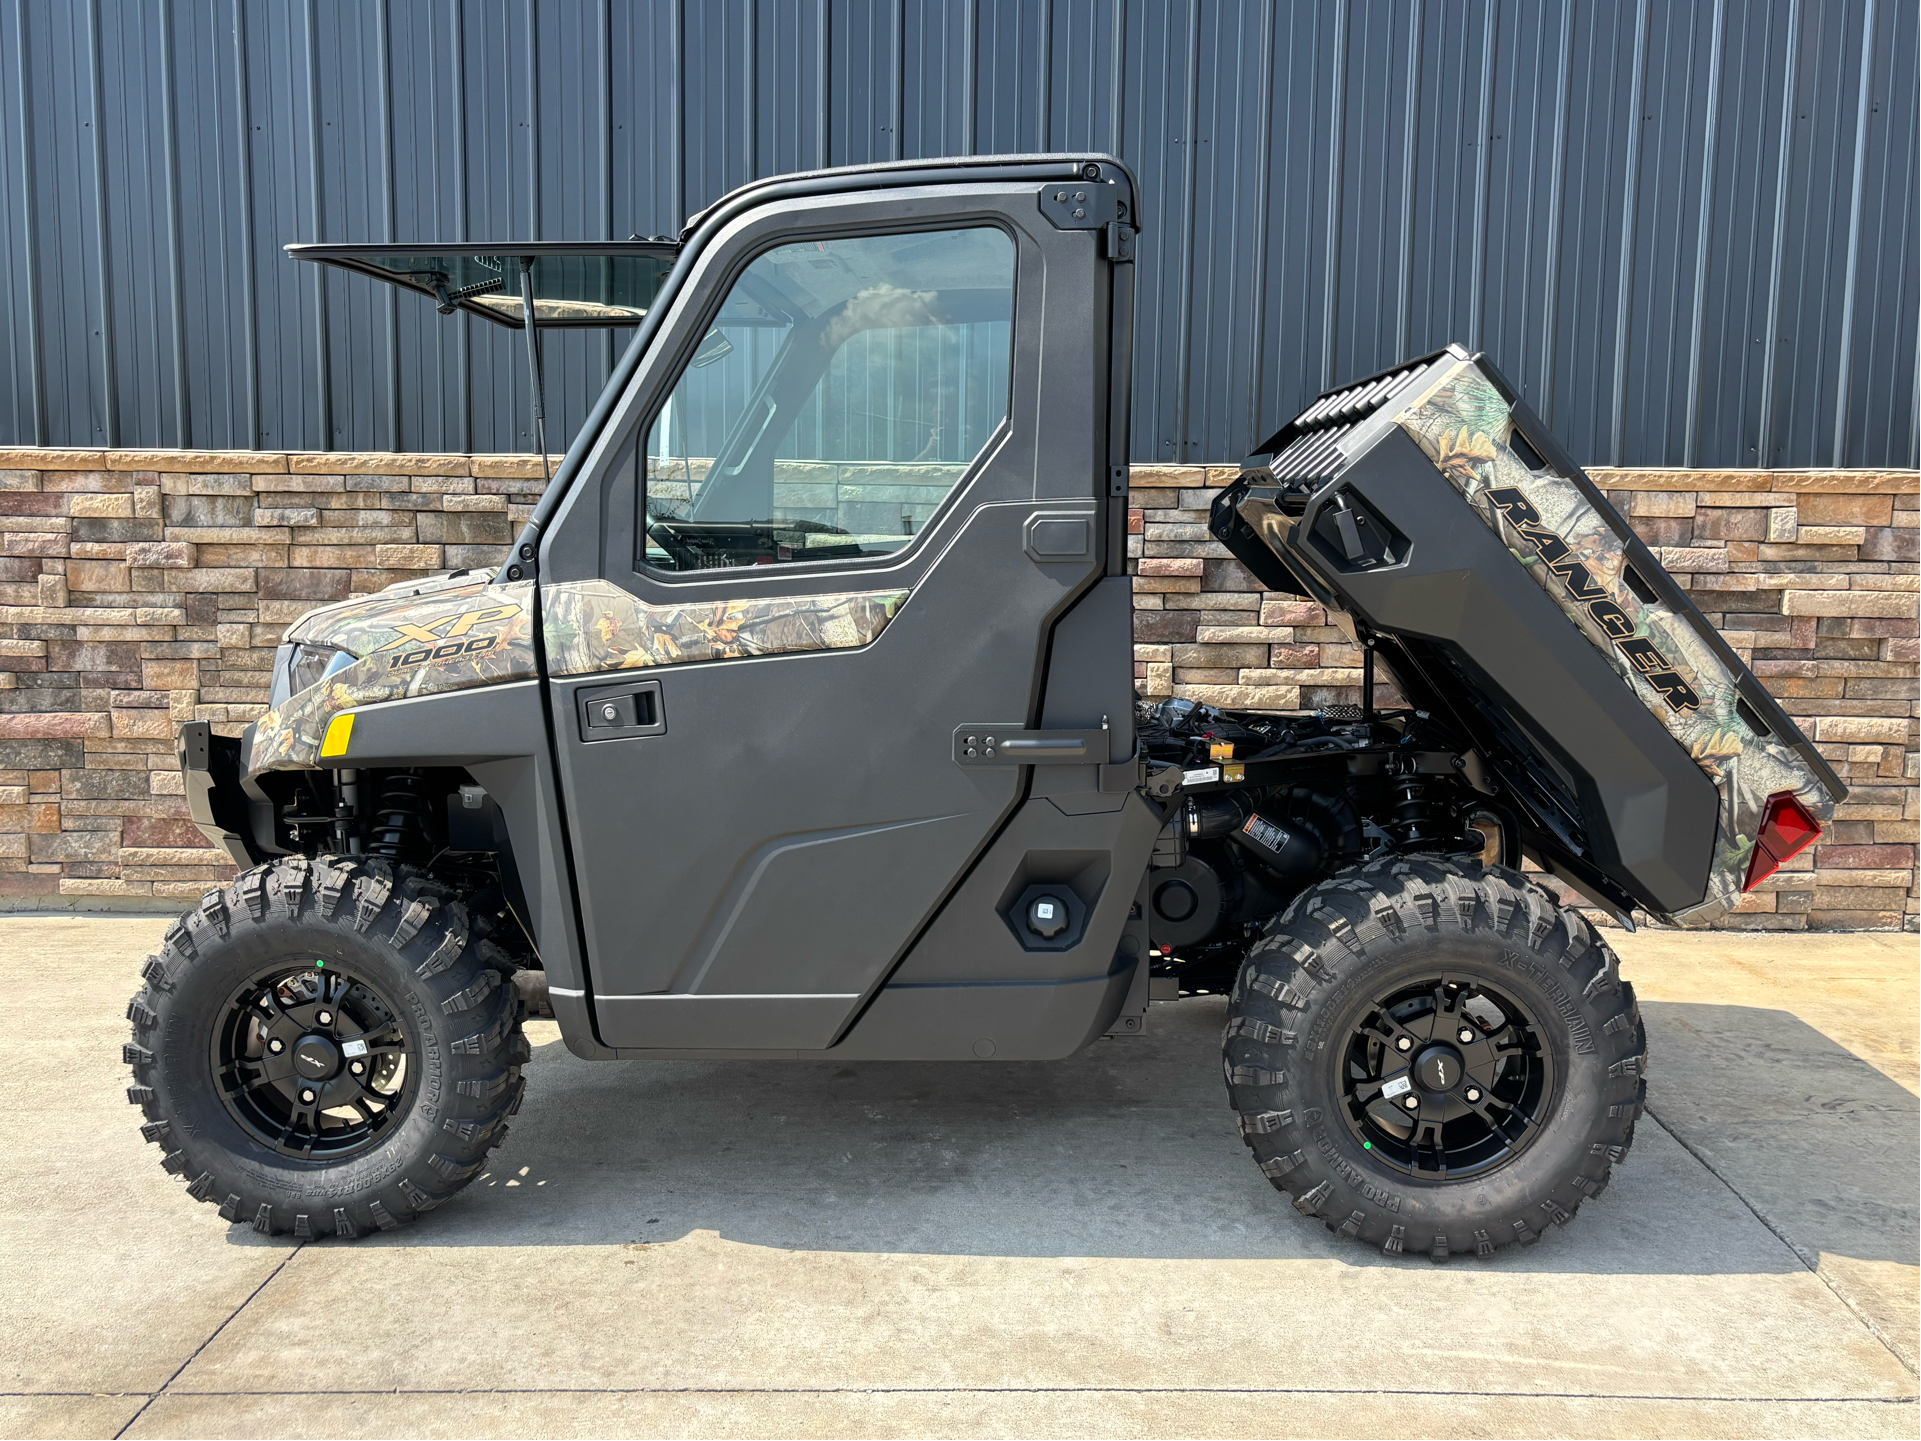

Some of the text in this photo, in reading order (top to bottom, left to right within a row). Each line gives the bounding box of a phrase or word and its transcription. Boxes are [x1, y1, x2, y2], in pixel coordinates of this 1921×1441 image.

[370, 603, 523, 654] XP
[1484, 486, 1702, 713] RANGER
[388, 635, 499, 671] 1000
[1496, 946, 1595, 1056] X-TERRAIN
[404, 991, 443, 1104] PRO ARMOR
[1437, 1058, 1445, 1085] XP
[1312, 1124, 1401, 1213] PRO ARMOR
